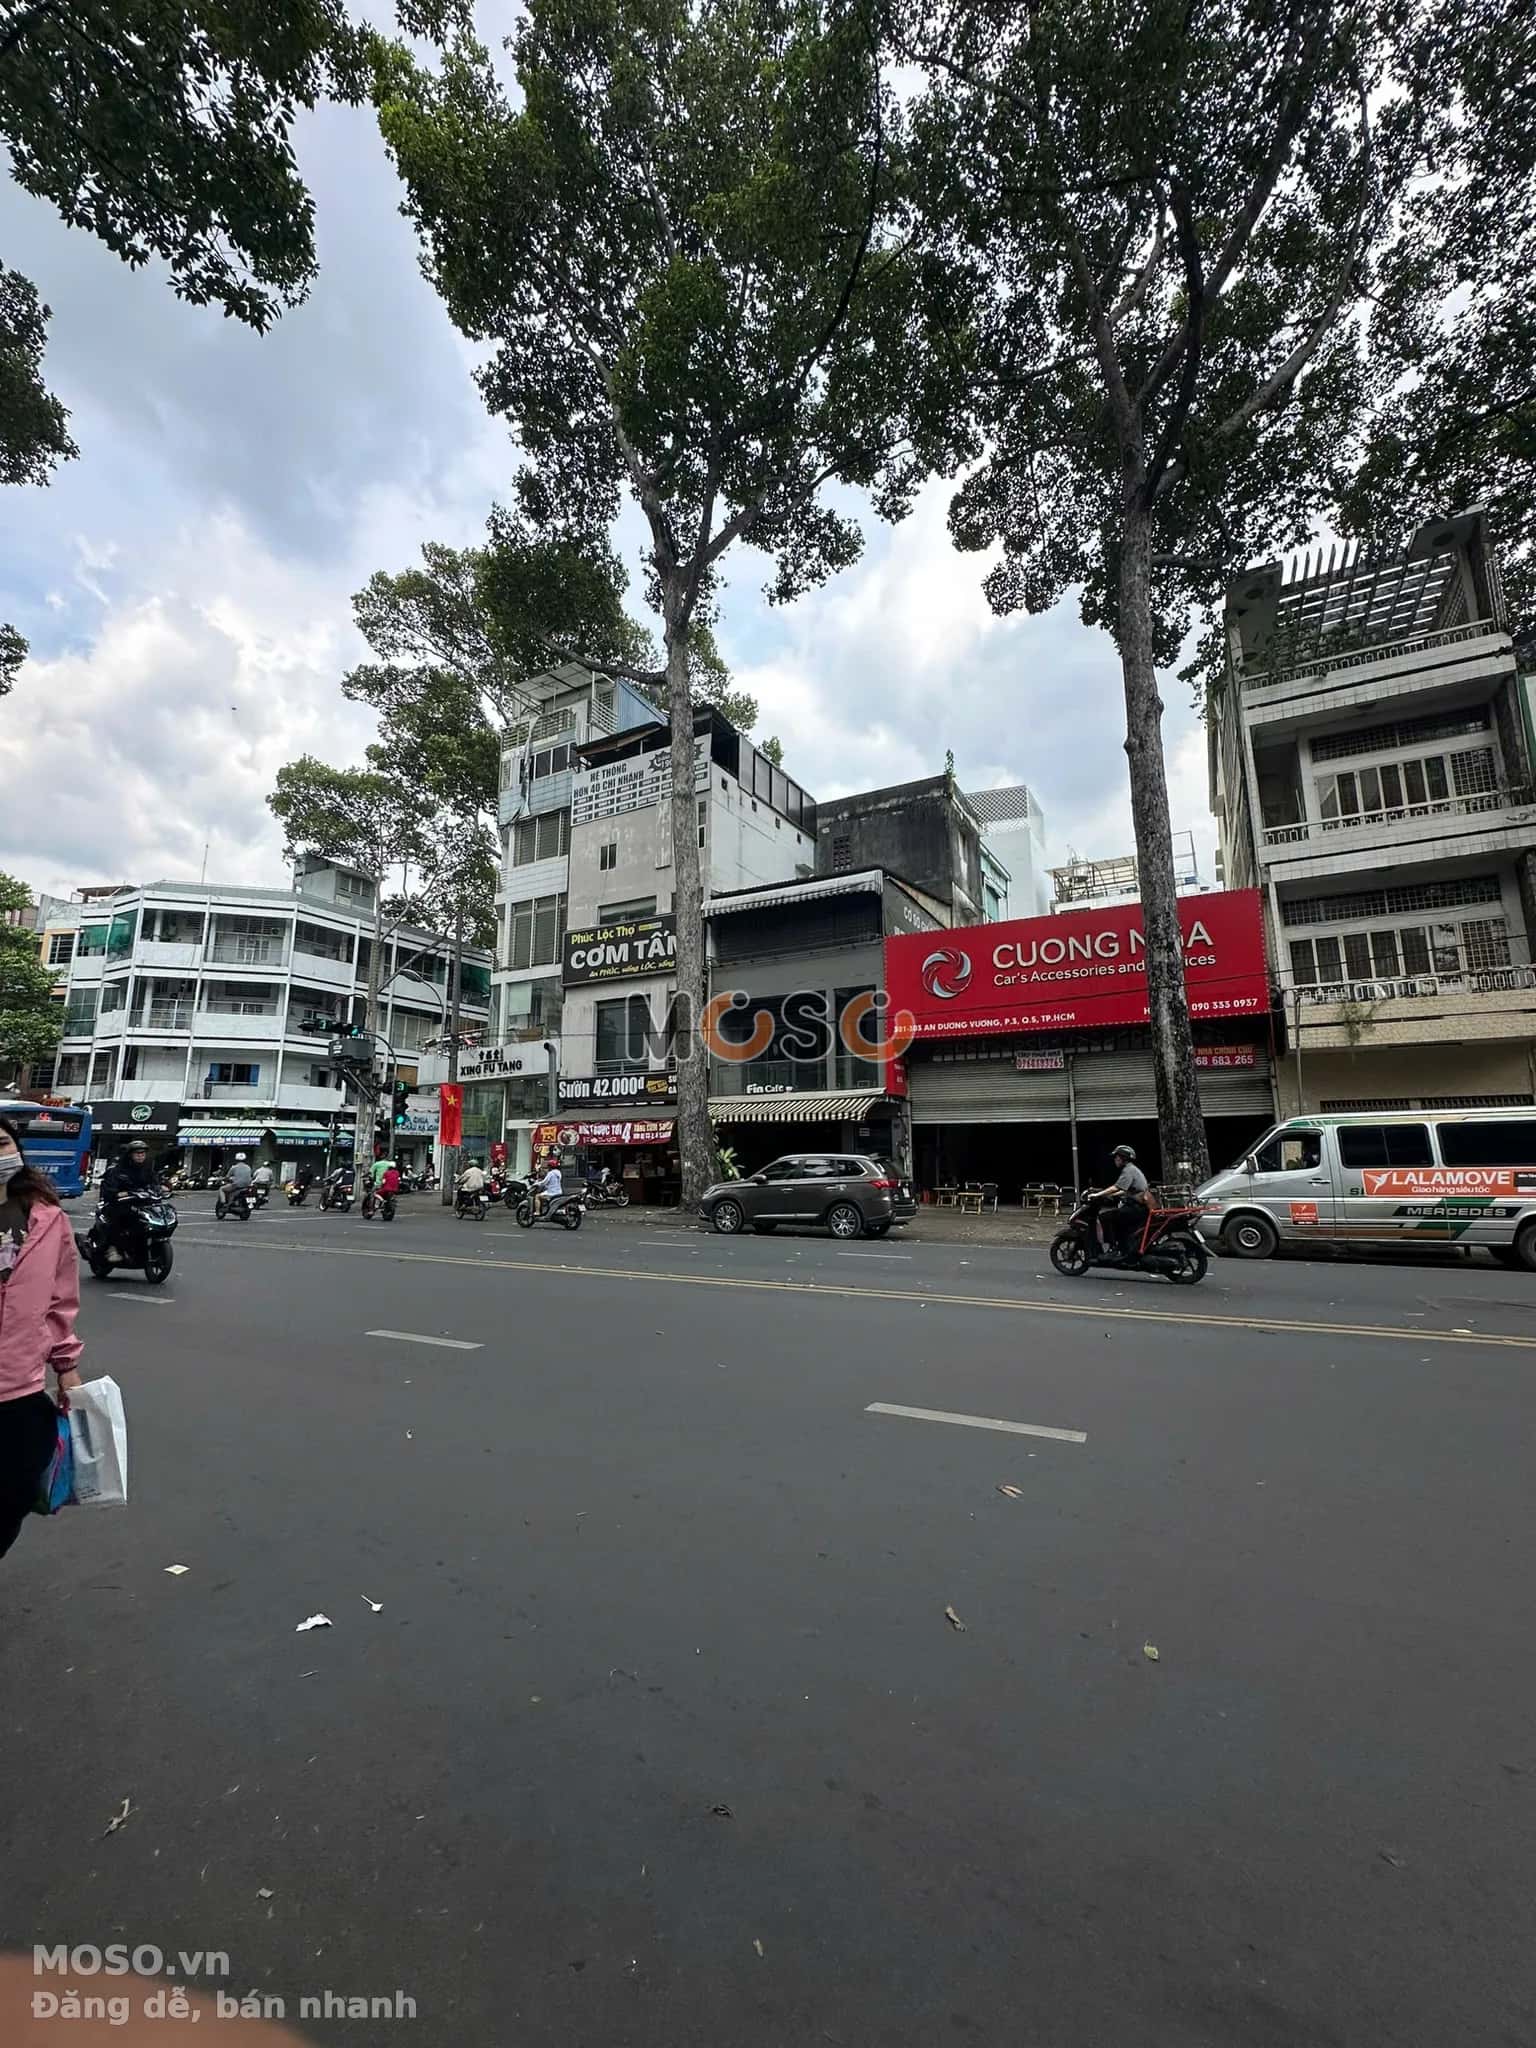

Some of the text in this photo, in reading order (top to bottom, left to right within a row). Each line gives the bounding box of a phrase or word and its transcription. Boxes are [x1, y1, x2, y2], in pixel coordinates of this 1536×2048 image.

[602, 777, 616, 790] CHI
[571, 932, 594, 945] Phúc
[597, 928, 615, 942] Lộc
[616, 925, 636, 937] Thọ
[993, 920, 1214, 969] CUONG NA
[570, 942, 629, 970] CƠM
[993, 966, 1028, 987] Car's
[1030, 962, 1117, 983] Accessories
[1118, 959, 1145, 975] and
[1191, 1002, 1209, 1012] 090
[1233, 998, 1259, 1008] 0937
[924, 1023, 936, 1032] AN
[1041, 1013, 1076, 1023] TP.HCM
[460, 1065, 482, 1076] XING
[483, 1062, 496, 1073] FU
[497, 1060, 522, 1072] TANG
[1212, 1055, 1231, 1065] 683
[1234, 1055, 1254, 1065] 265
[559, 1080, 590, 1098] Sườn
[593, 1076, 645, 1097] 42.000đ
[746, 1083, 764, 1094] Fin
[621, 1122, 631, 1143] 4
[1391, 1170, 1511, 1186] LALAMOVE
[1407, 1206, 1507, 1216] MERCEDES
